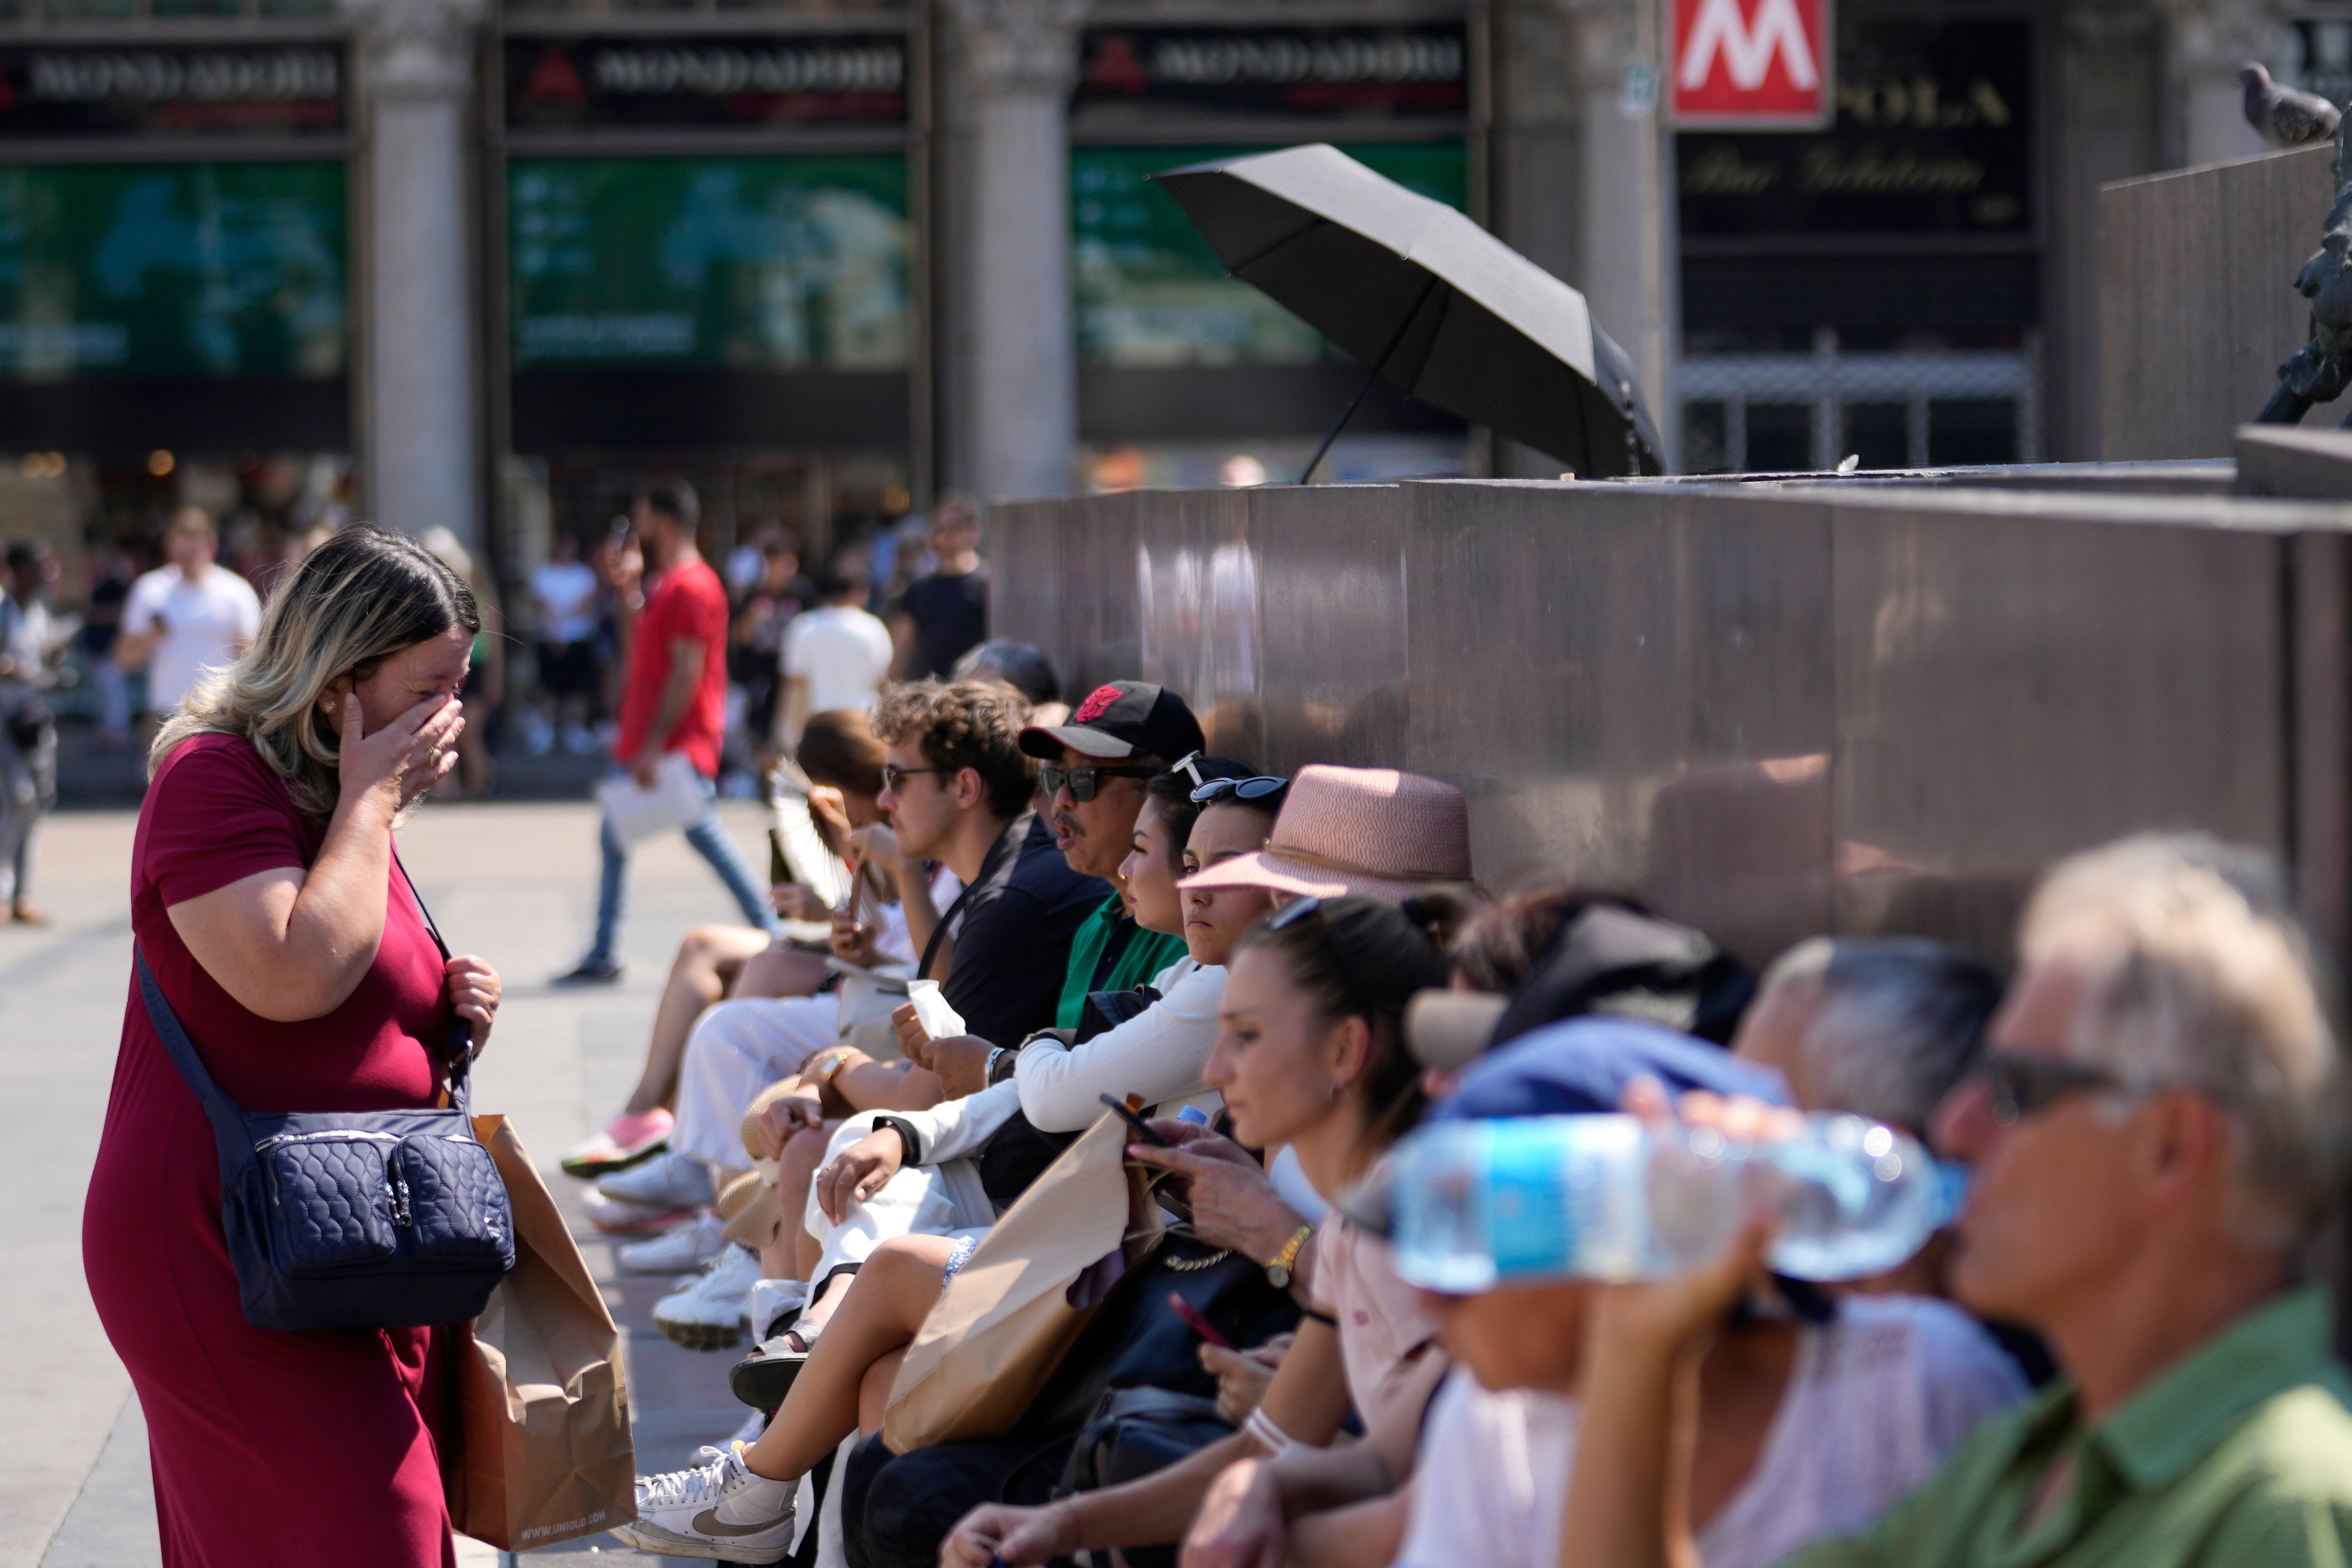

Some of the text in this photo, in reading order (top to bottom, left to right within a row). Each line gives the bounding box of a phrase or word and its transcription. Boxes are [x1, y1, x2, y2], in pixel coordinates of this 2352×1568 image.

[1158, 35, 1462, 83] MONDADORI
[1679, 0, 1820, 90] M
[32, 54, 338, 101] MONDADORI
[595, 46, 904, 94] MONDADORI
[1837, 75, 2012, 129] OLA
[522, 1510, 606, 1540] WWW.UNIQLO.COM
